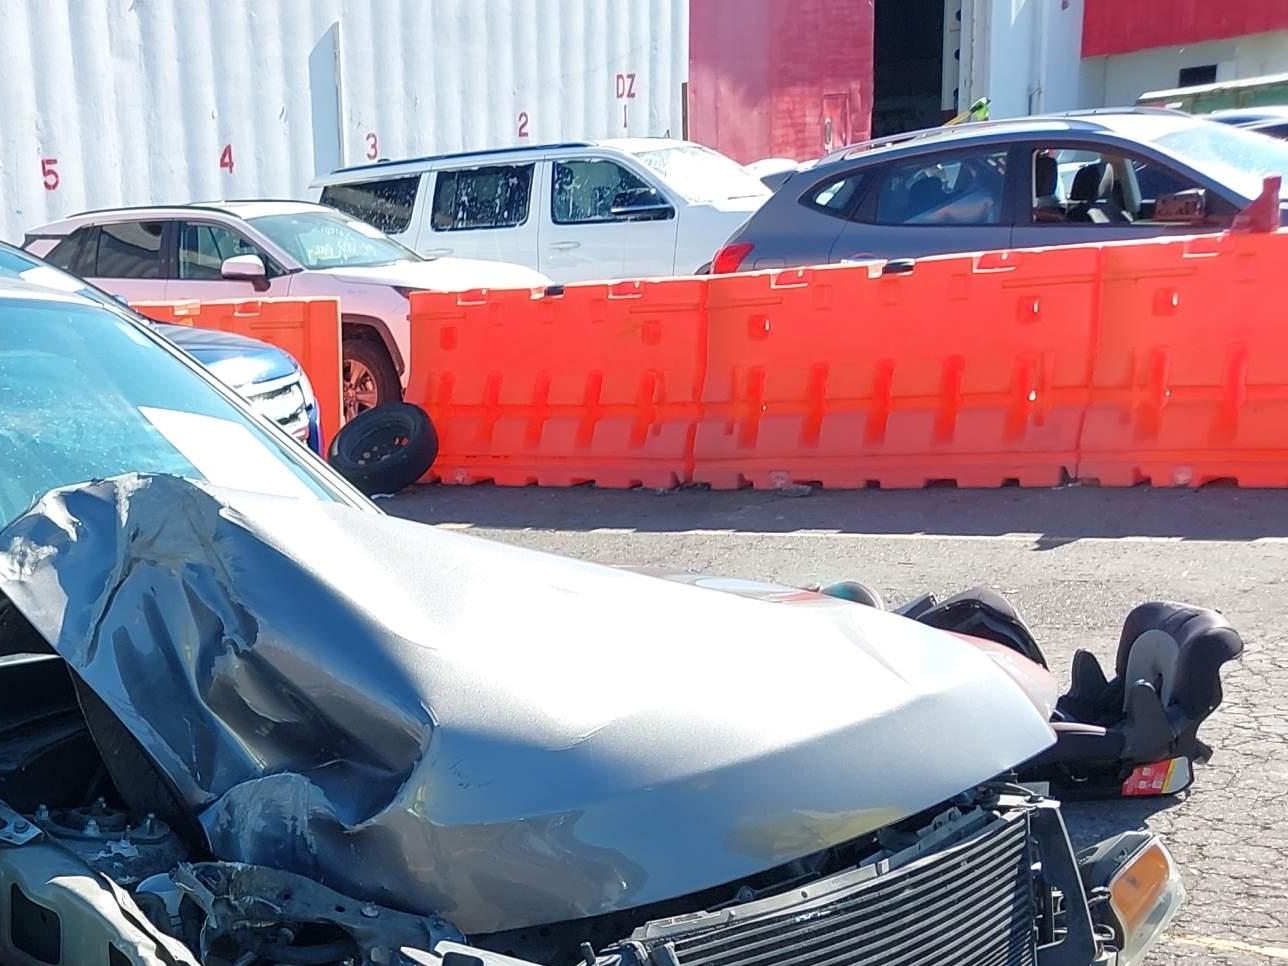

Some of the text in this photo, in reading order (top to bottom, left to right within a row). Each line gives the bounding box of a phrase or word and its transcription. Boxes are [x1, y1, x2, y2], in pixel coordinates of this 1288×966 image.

[615, 73, 636, 99] DZ
[518, 111, 529, 137] 2
[219, 143, 234, 174] 4
[366, 132, 378, 160] 3
[41, 158, 60, 191] 5
